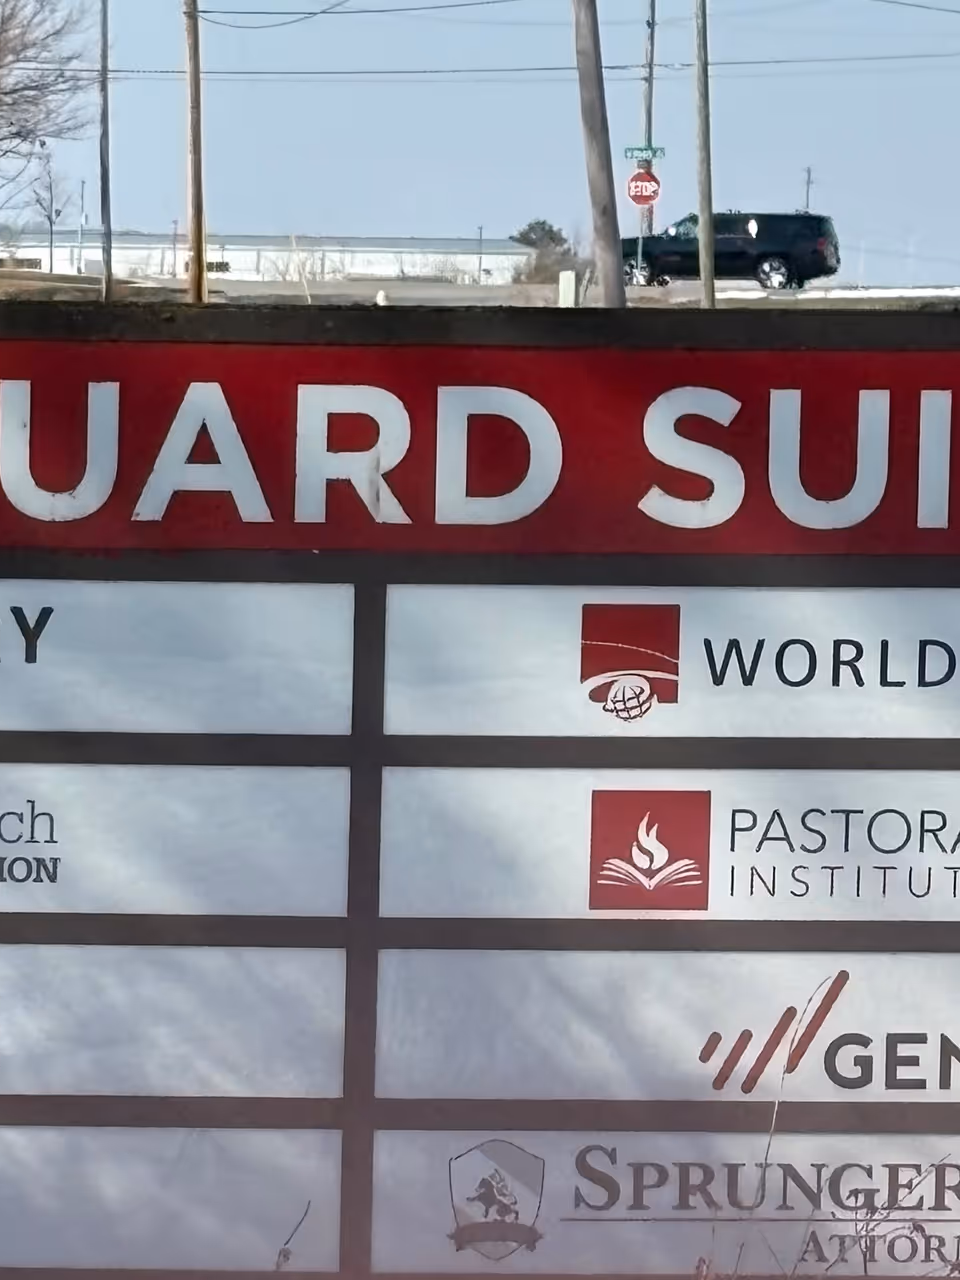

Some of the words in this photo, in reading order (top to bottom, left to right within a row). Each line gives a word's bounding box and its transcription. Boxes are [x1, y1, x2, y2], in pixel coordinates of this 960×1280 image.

[637, 386, 953, 530] SUI
[703, 637, 957, 688] WORLD
[729, 808, 960, 855] PASTOR
[729, 865, 960, 899] INSTITUT
[573, 1145, 960, 1213] SPRUNGER
[798, 1229, 960, 1264] ATTOR
